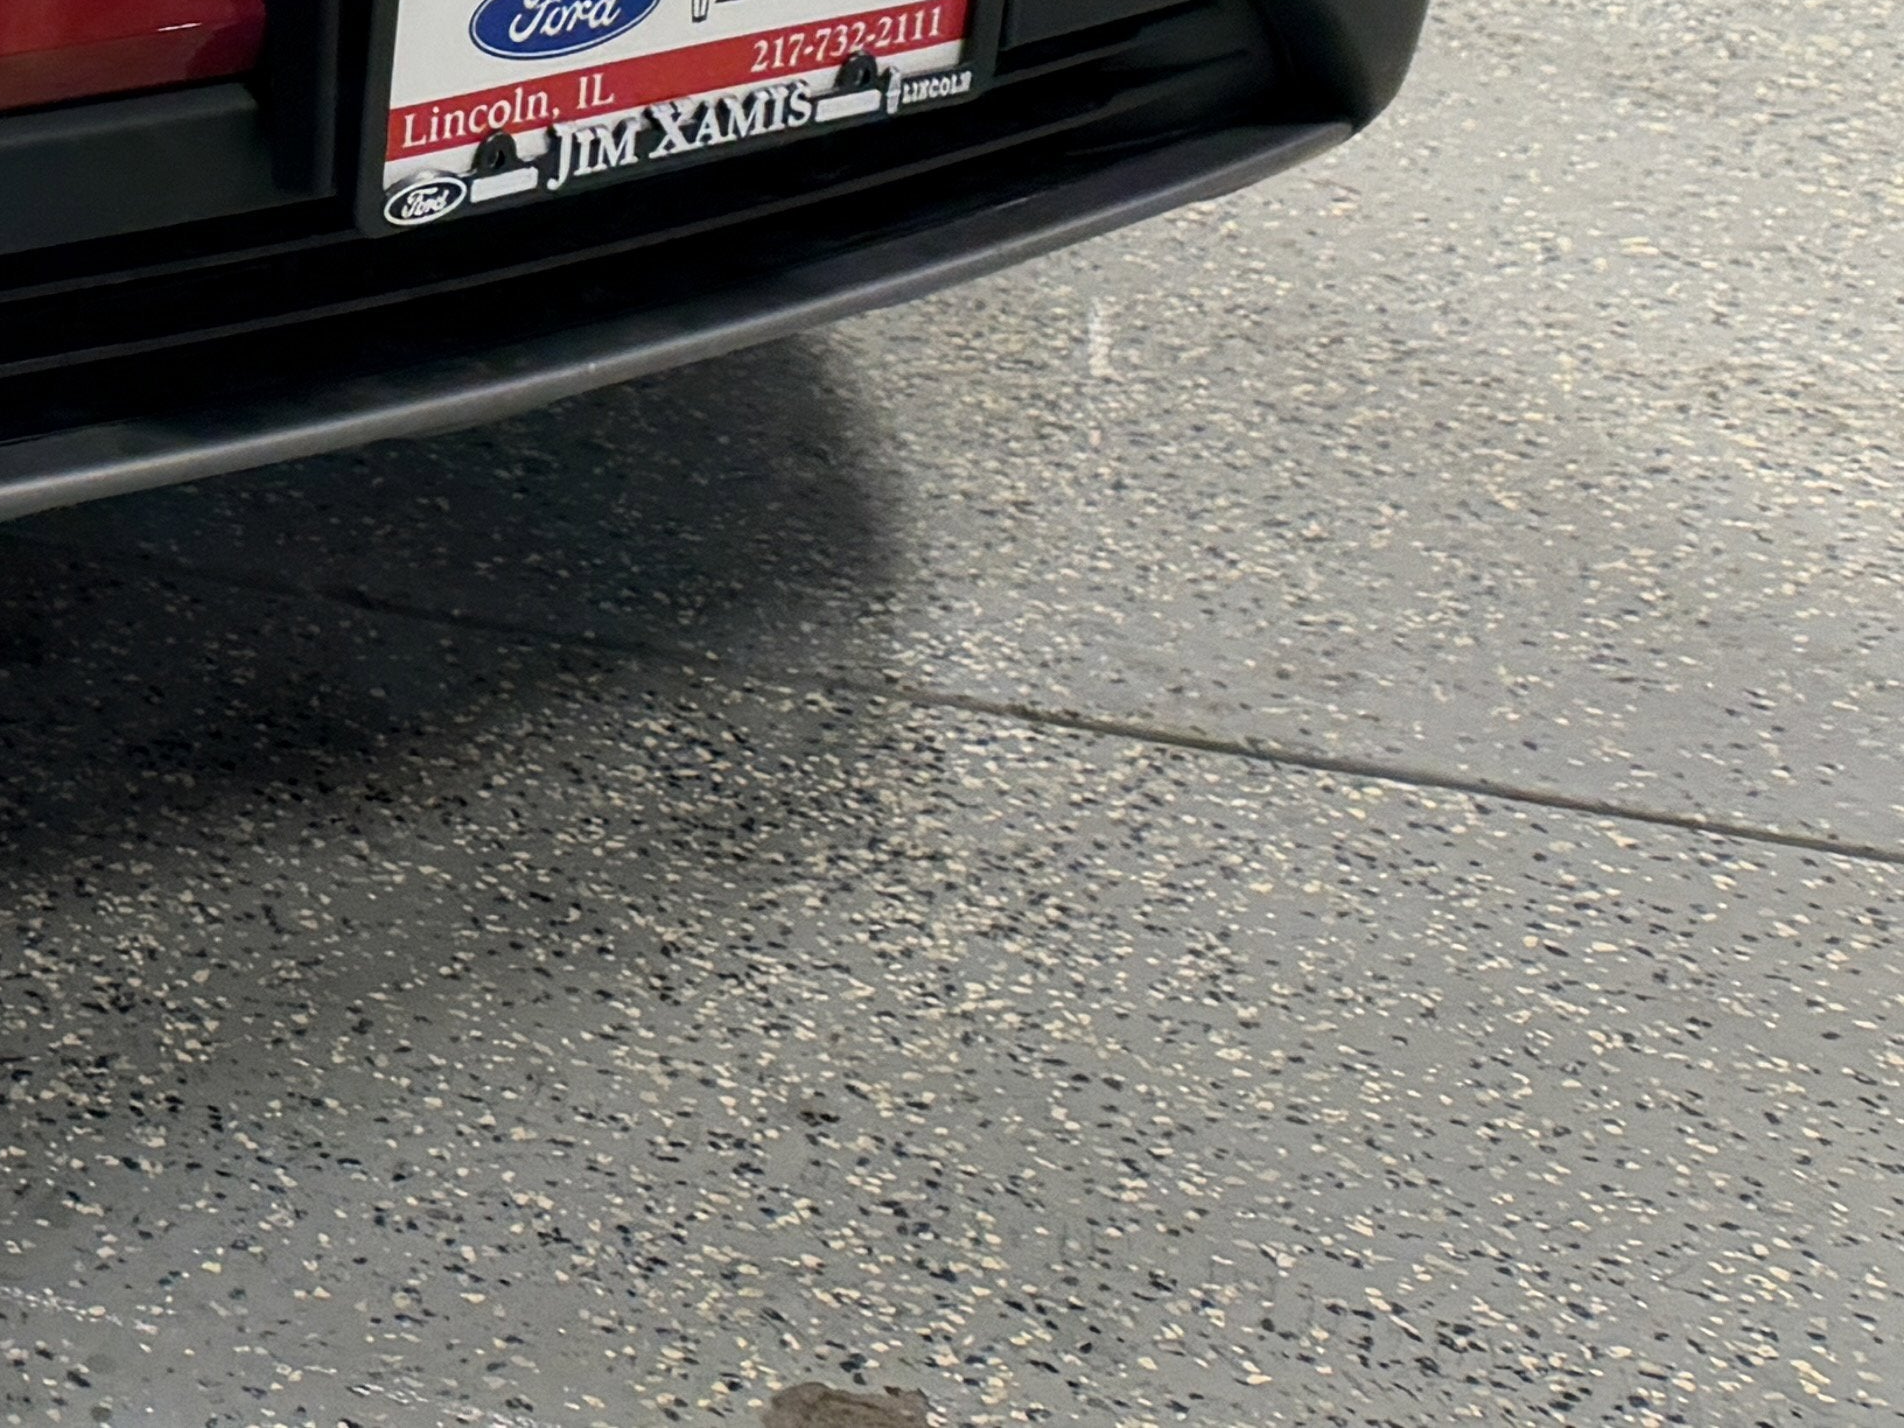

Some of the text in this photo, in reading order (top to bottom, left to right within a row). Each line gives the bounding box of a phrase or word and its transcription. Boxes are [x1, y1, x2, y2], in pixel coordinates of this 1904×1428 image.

[749, 4, 943, 74] 217-732-2111
[402, 73, 617, 149] Lincoln, IL
